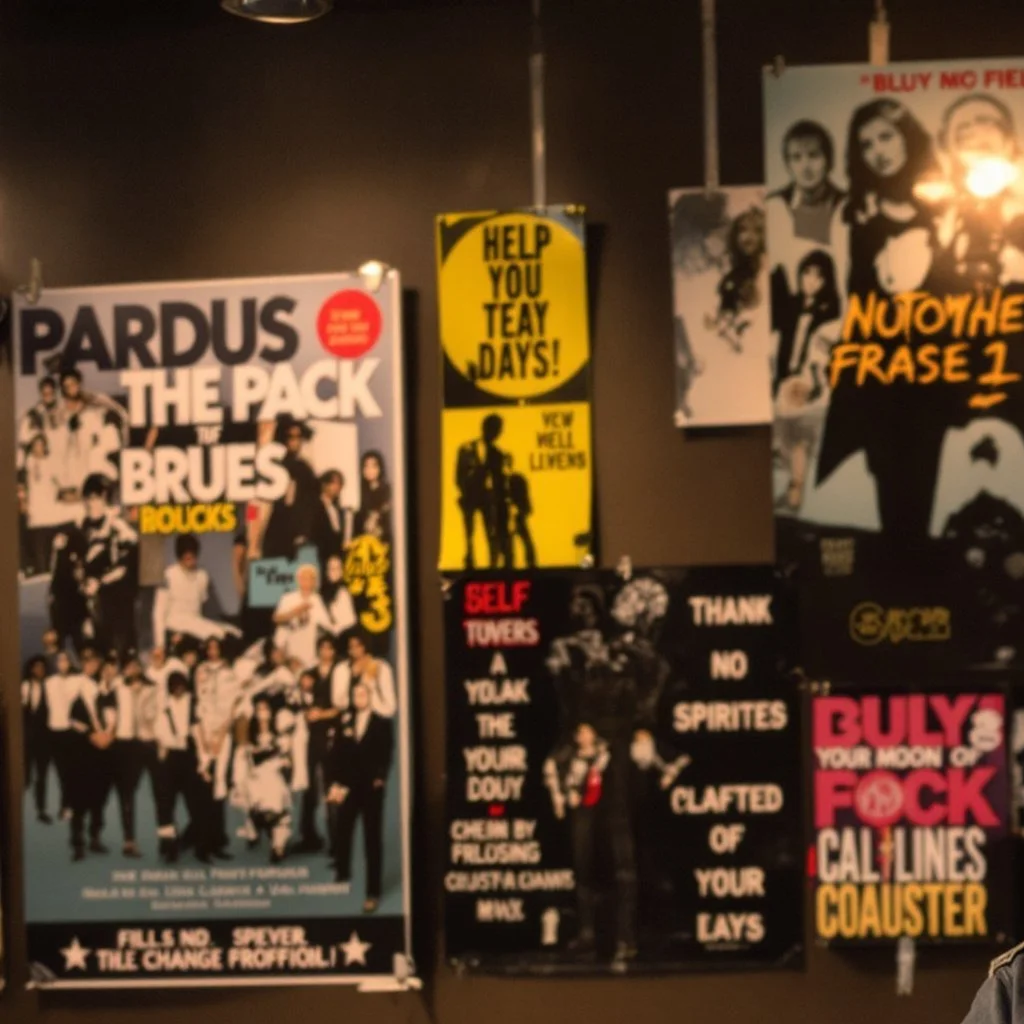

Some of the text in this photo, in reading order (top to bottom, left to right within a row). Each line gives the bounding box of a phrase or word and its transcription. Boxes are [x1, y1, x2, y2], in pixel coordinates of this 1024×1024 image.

[482, 223, 552, 262] HELP
[488, 263, 542, 300] YOU
[18, 294, 299, 376] PARDUS
[483, 301, 549, 339] TEAY
[478, 339, 561, 381] DAYS!
[829, 341, 971, 388] FRASE
[119, 356, 382, 428] THE PACK
[119, 440, 290, 506] BRUES
[464, 580, 531, 614] SELF
[688, 593, 774, 627] THANK
[489, 650, 508, 675] A
[709, 649, 750, 681] NO
[475, 712, 517, 739] THE
[672, 699, 788, 734] SPIRITES
[814, 746, 873, 770] YOUR
[875, 745, 943, 769] MOON
[670, 782, 785, 816] CLAFTED
[708, 822, 746, 856] OF
[693, 865, 766, 899] YOUR
[815, 881, 988, 939] COAUSTER
[141, 947, 224, 971] CHANGE
